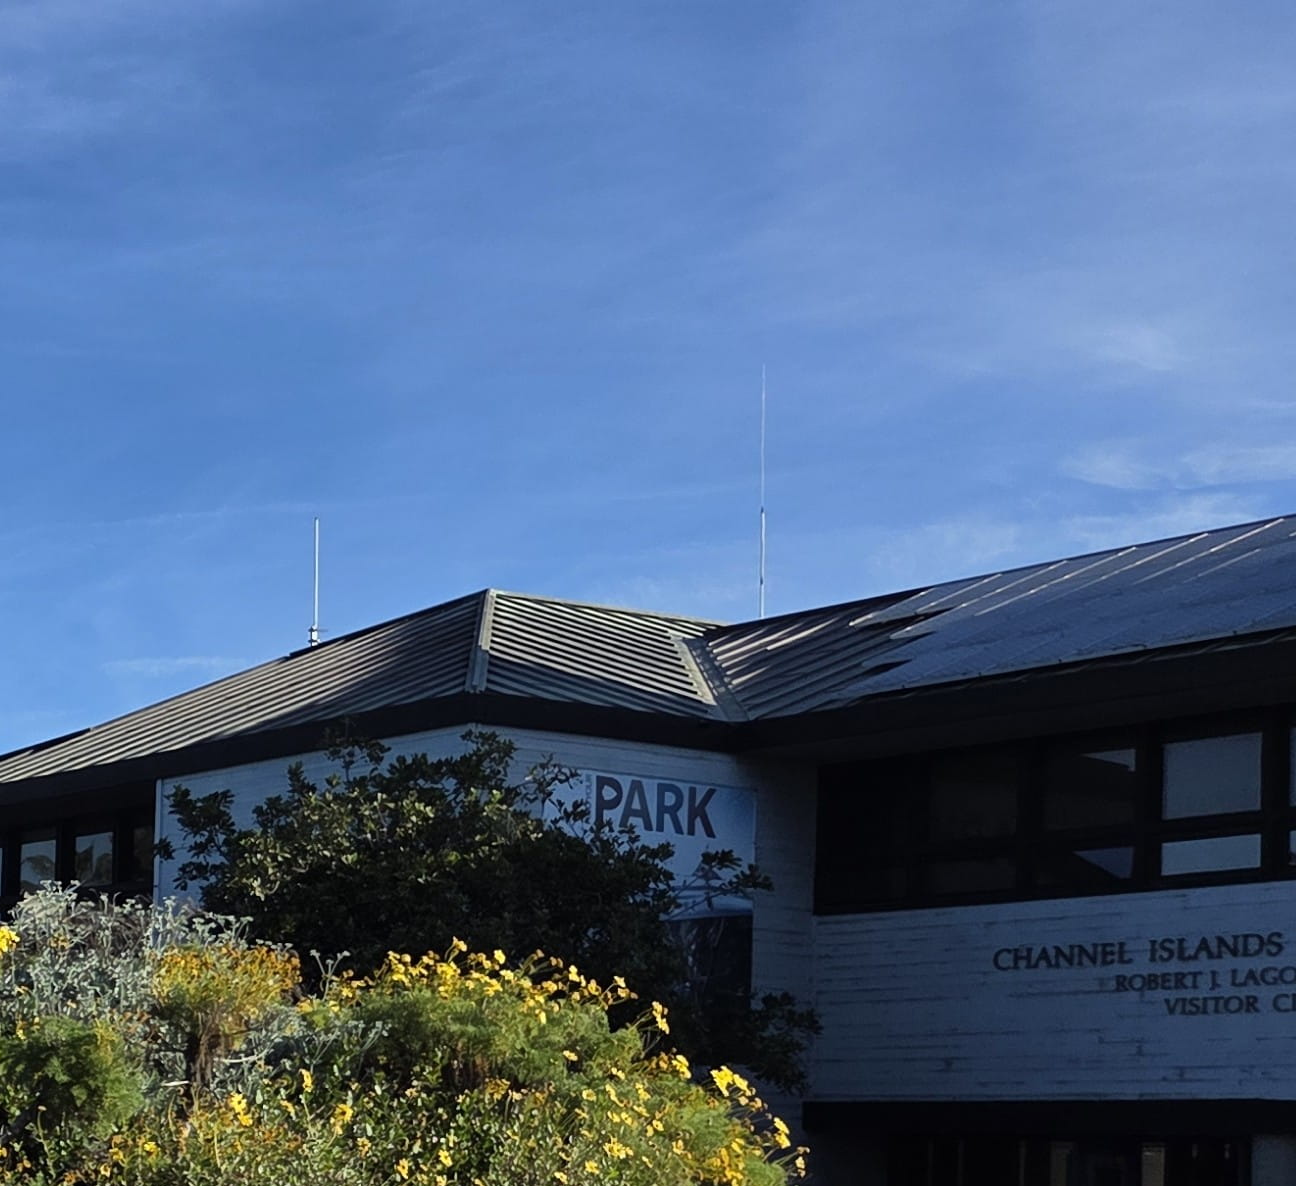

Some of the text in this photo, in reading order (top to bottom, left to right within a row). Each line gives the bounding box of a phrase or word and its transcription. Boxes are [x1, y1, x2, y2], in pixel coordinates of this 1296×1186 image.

[595, 775, 716, 839] PARK
[993, 931, 1284, 971] CHANNEL ISLANDS
[1115, 971, 1204, 993] ROBERT
[1164, 994, 1260, 1016] VISITOR
